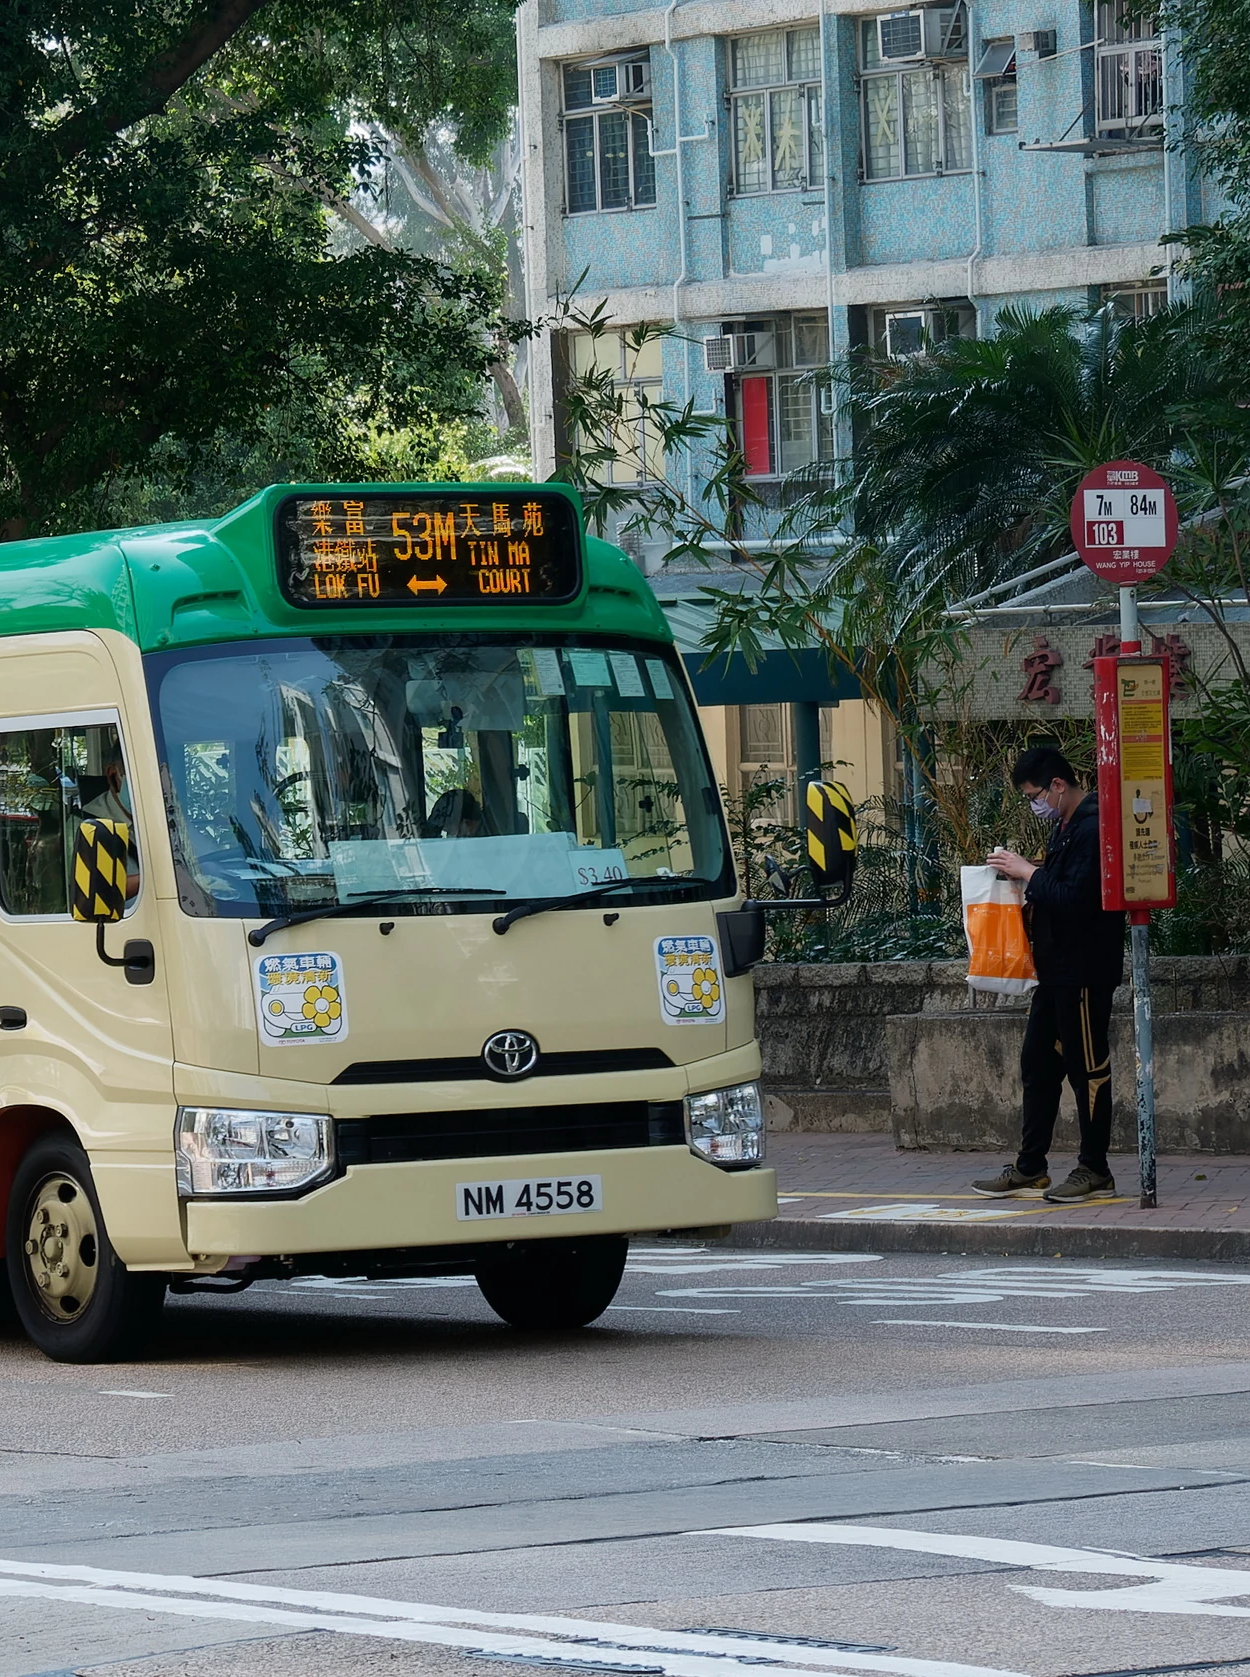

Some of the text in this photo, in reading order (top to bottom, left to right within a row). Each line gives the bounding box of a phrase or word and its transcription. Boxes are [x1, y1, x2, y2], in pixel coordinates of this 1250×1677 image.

[1114, 470, 1139, 482] KMB
[1095, 494, 1157, 516] 7M 84M
[310, 500, 365, 536] 樂富
[459, 502, 544, 538] 天馬苑
[391, 512, 457, 560] 53M
[1092, 522, 1118, 545] 103
[467, 541, 531, 566] TIN MA
[1095, 560, 1156, 569] WANG YIP HOUSE
[314, 573, 380, 599] LOK FU
[478, 568, 531, 594] COURT
[577, 865, 623, 886] $340
[294, 1023, 313, 1032] LPG
[463, 1180, 595, 1216] NM 4558
